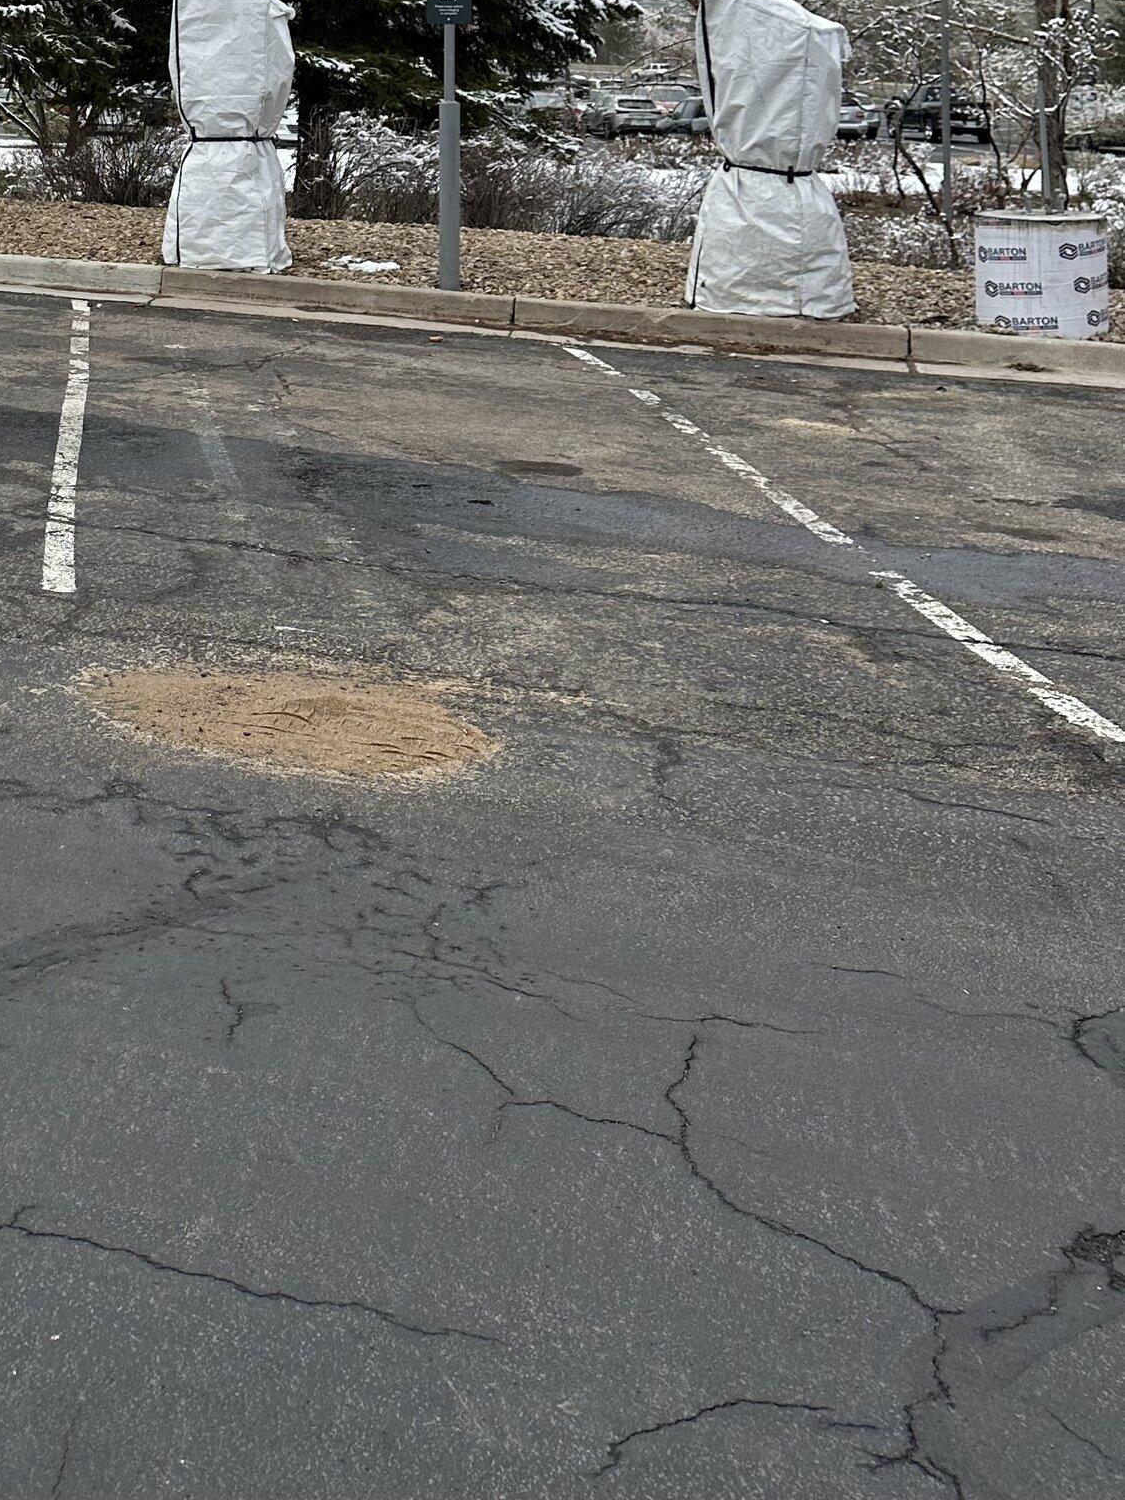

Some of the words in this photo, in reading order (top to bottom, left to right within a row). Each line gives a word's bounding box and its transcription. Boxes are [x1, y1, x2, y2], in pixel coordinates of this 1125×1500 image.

[987, 247, 1027, 256] BARTON
[998, 282, 1043, 291] BARTON
[1011, 316, 1059, 326] BARTON
